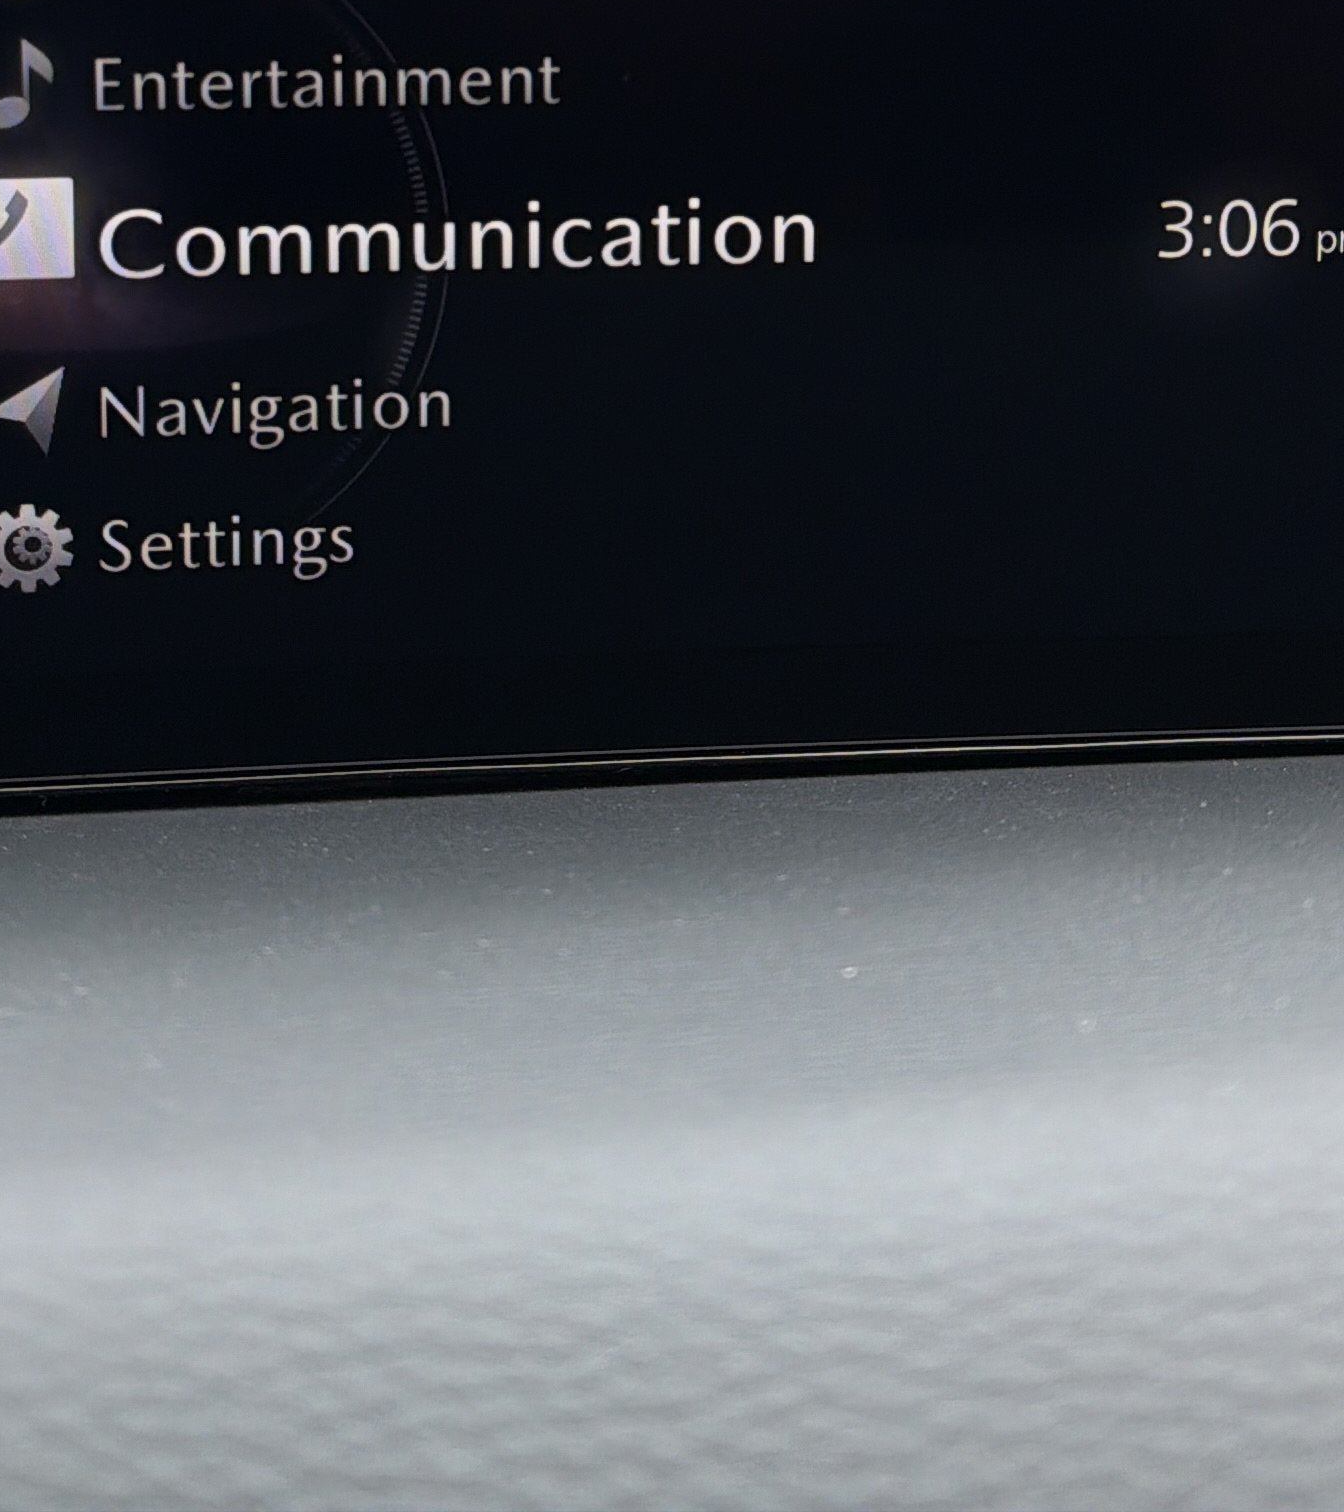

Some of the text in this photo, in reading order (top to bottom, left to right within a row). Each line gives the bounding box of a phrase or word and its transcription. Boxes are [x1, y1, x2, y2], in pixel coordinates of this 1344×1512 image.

[94, 53, 561, 111] Entertainment
[99, 197, 815, 282] Communication
[1158, 198, 1300, 259] 3:06
[100, 377, 450, 450] Navigation
[99, 514, 354, 581] Settings
